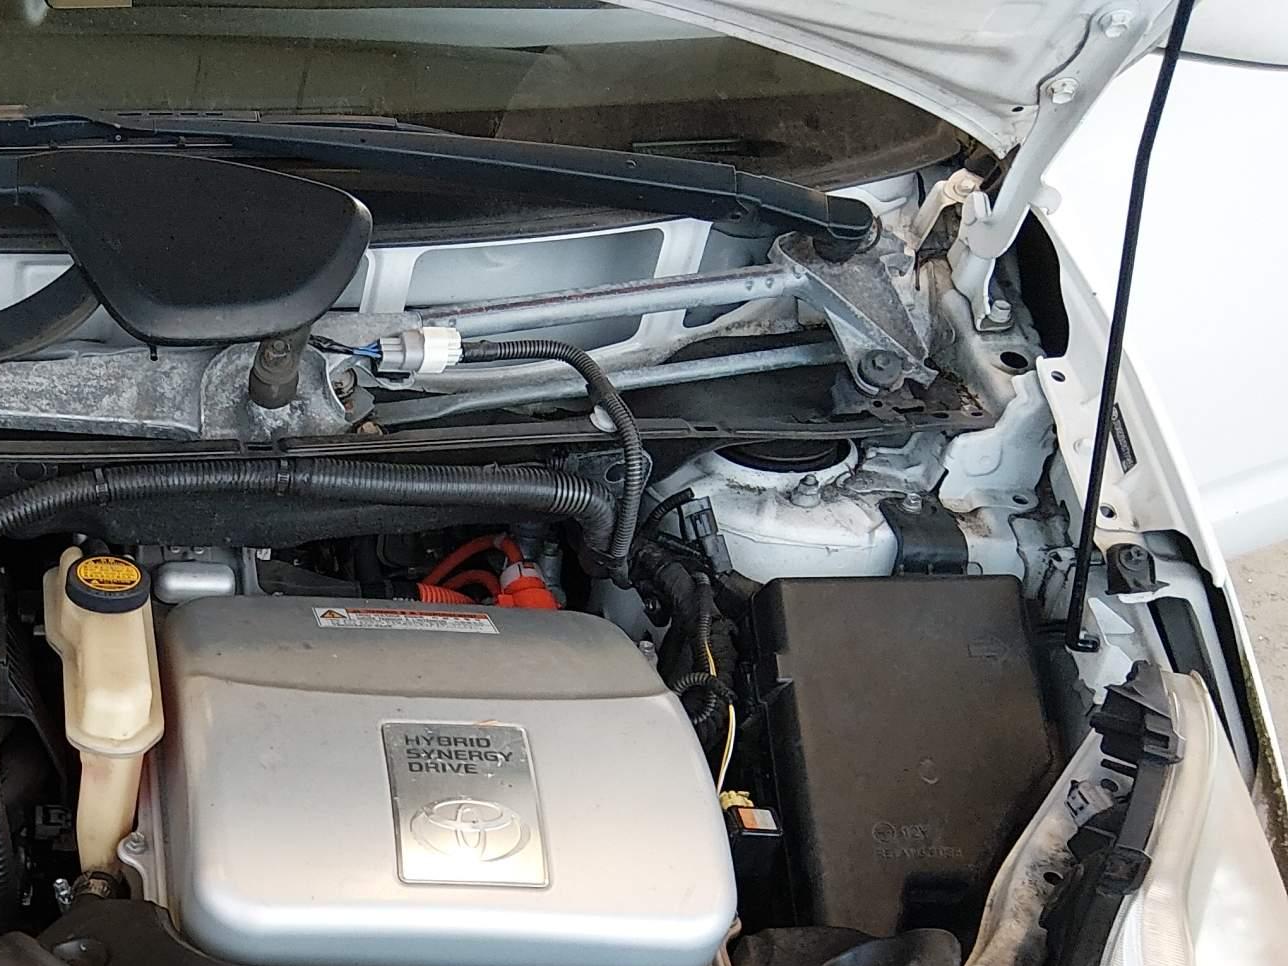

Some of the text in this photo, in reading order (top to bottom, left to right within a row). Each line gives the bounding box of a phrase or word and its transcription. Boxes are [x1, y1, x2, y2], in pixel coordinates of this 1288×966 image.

[404, 734, 491, 748] HYBRID
[406, 748, 513, 762] SYNERGY
[408, 761, 478, 774] DRIVE
